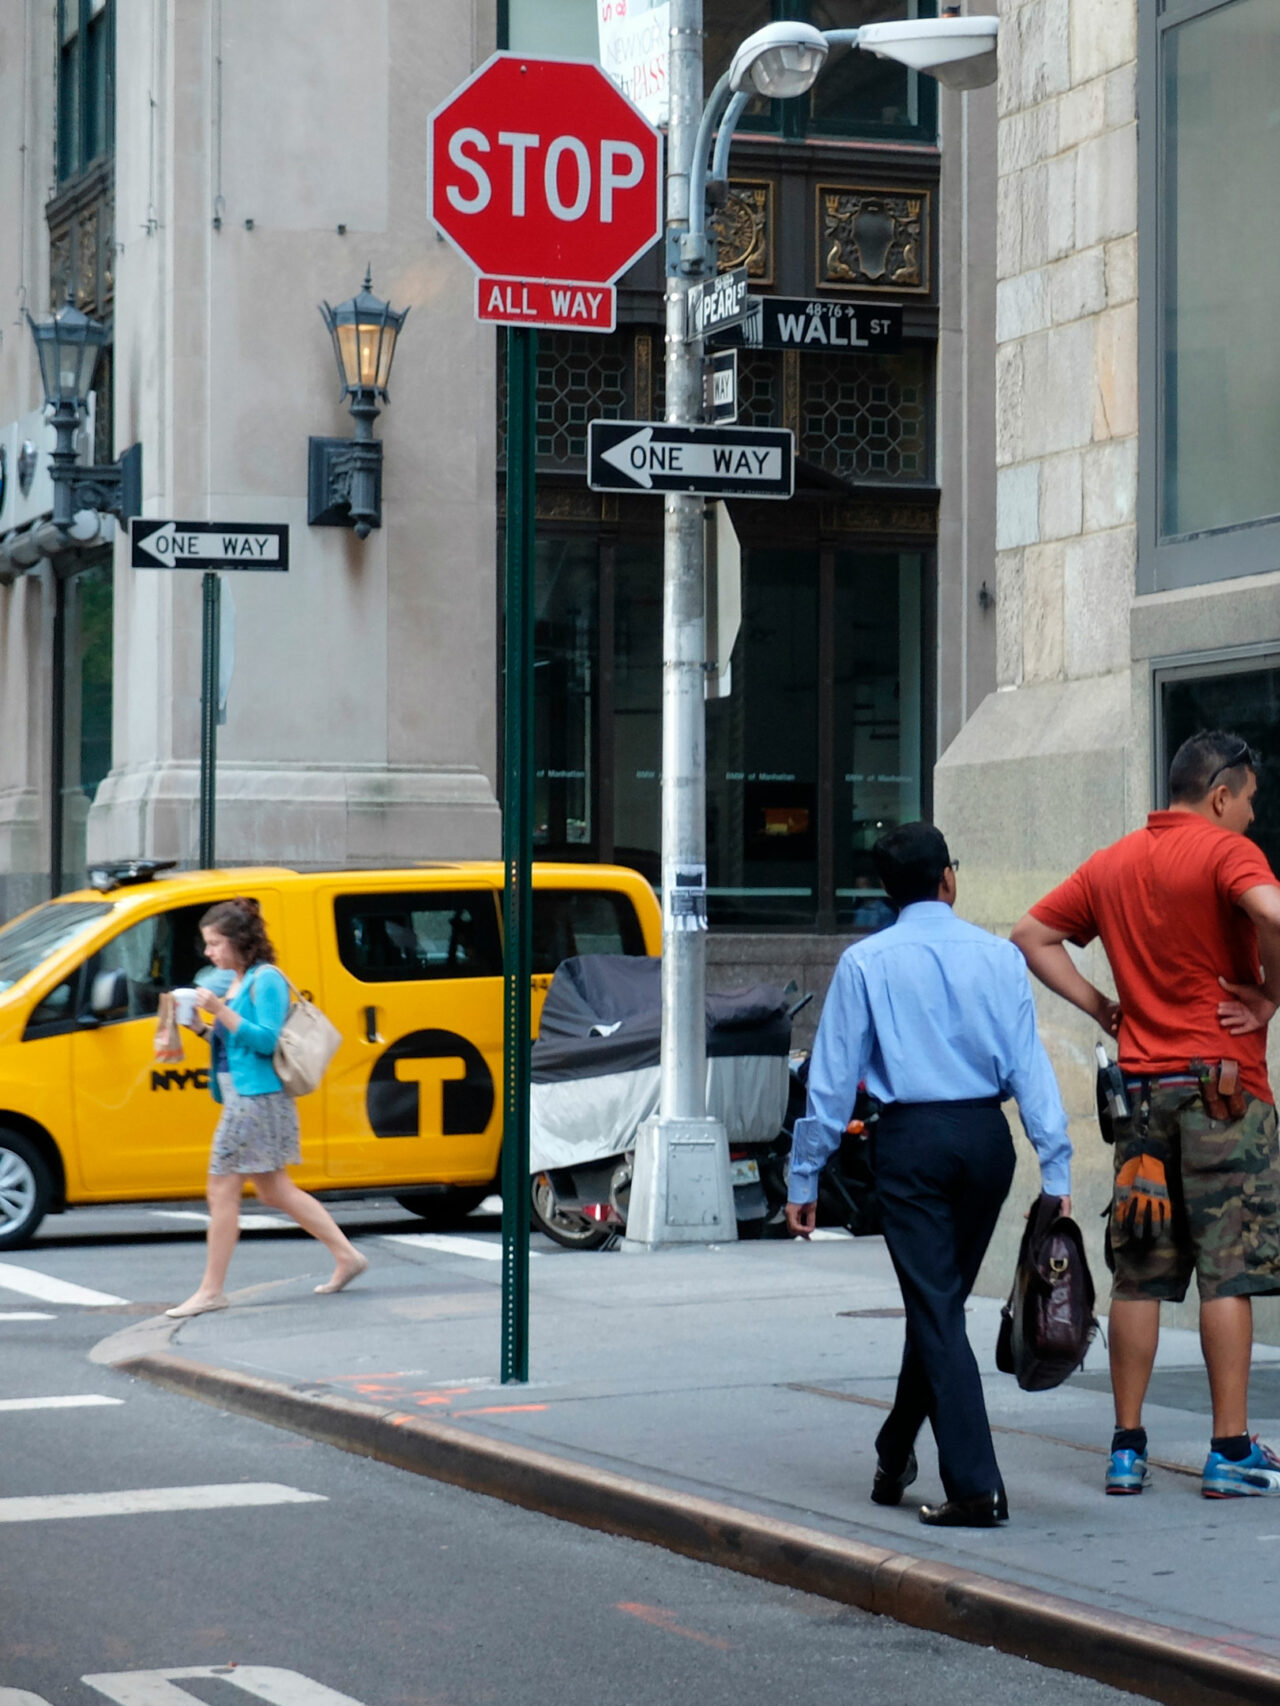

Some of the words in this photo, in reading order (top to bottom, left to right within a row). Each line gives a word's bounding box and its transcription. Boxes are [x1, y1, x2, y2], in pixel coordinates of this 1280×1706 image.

[446, 127, 645, 225] STOP
[487, 285, 537, 315] ALL
[550, 289, 603, 320] WAY
[703, 285, 740, 326] PEARL
[737, 281, 746, 299] ST
[806, 303, 843, 318] 48-76
[777, 313, 869, 347] WALL
[870, 319, 891, 335] ST
[714, 373, 731, 401] WAY
[630, 445, 683, 472] ONE
[713, 448, 770, 475] WAY
[155, 535, 199, 555] ONE
[222, 537, 269, 557] WAY
[151, 1069, 211, 1091] NYC
